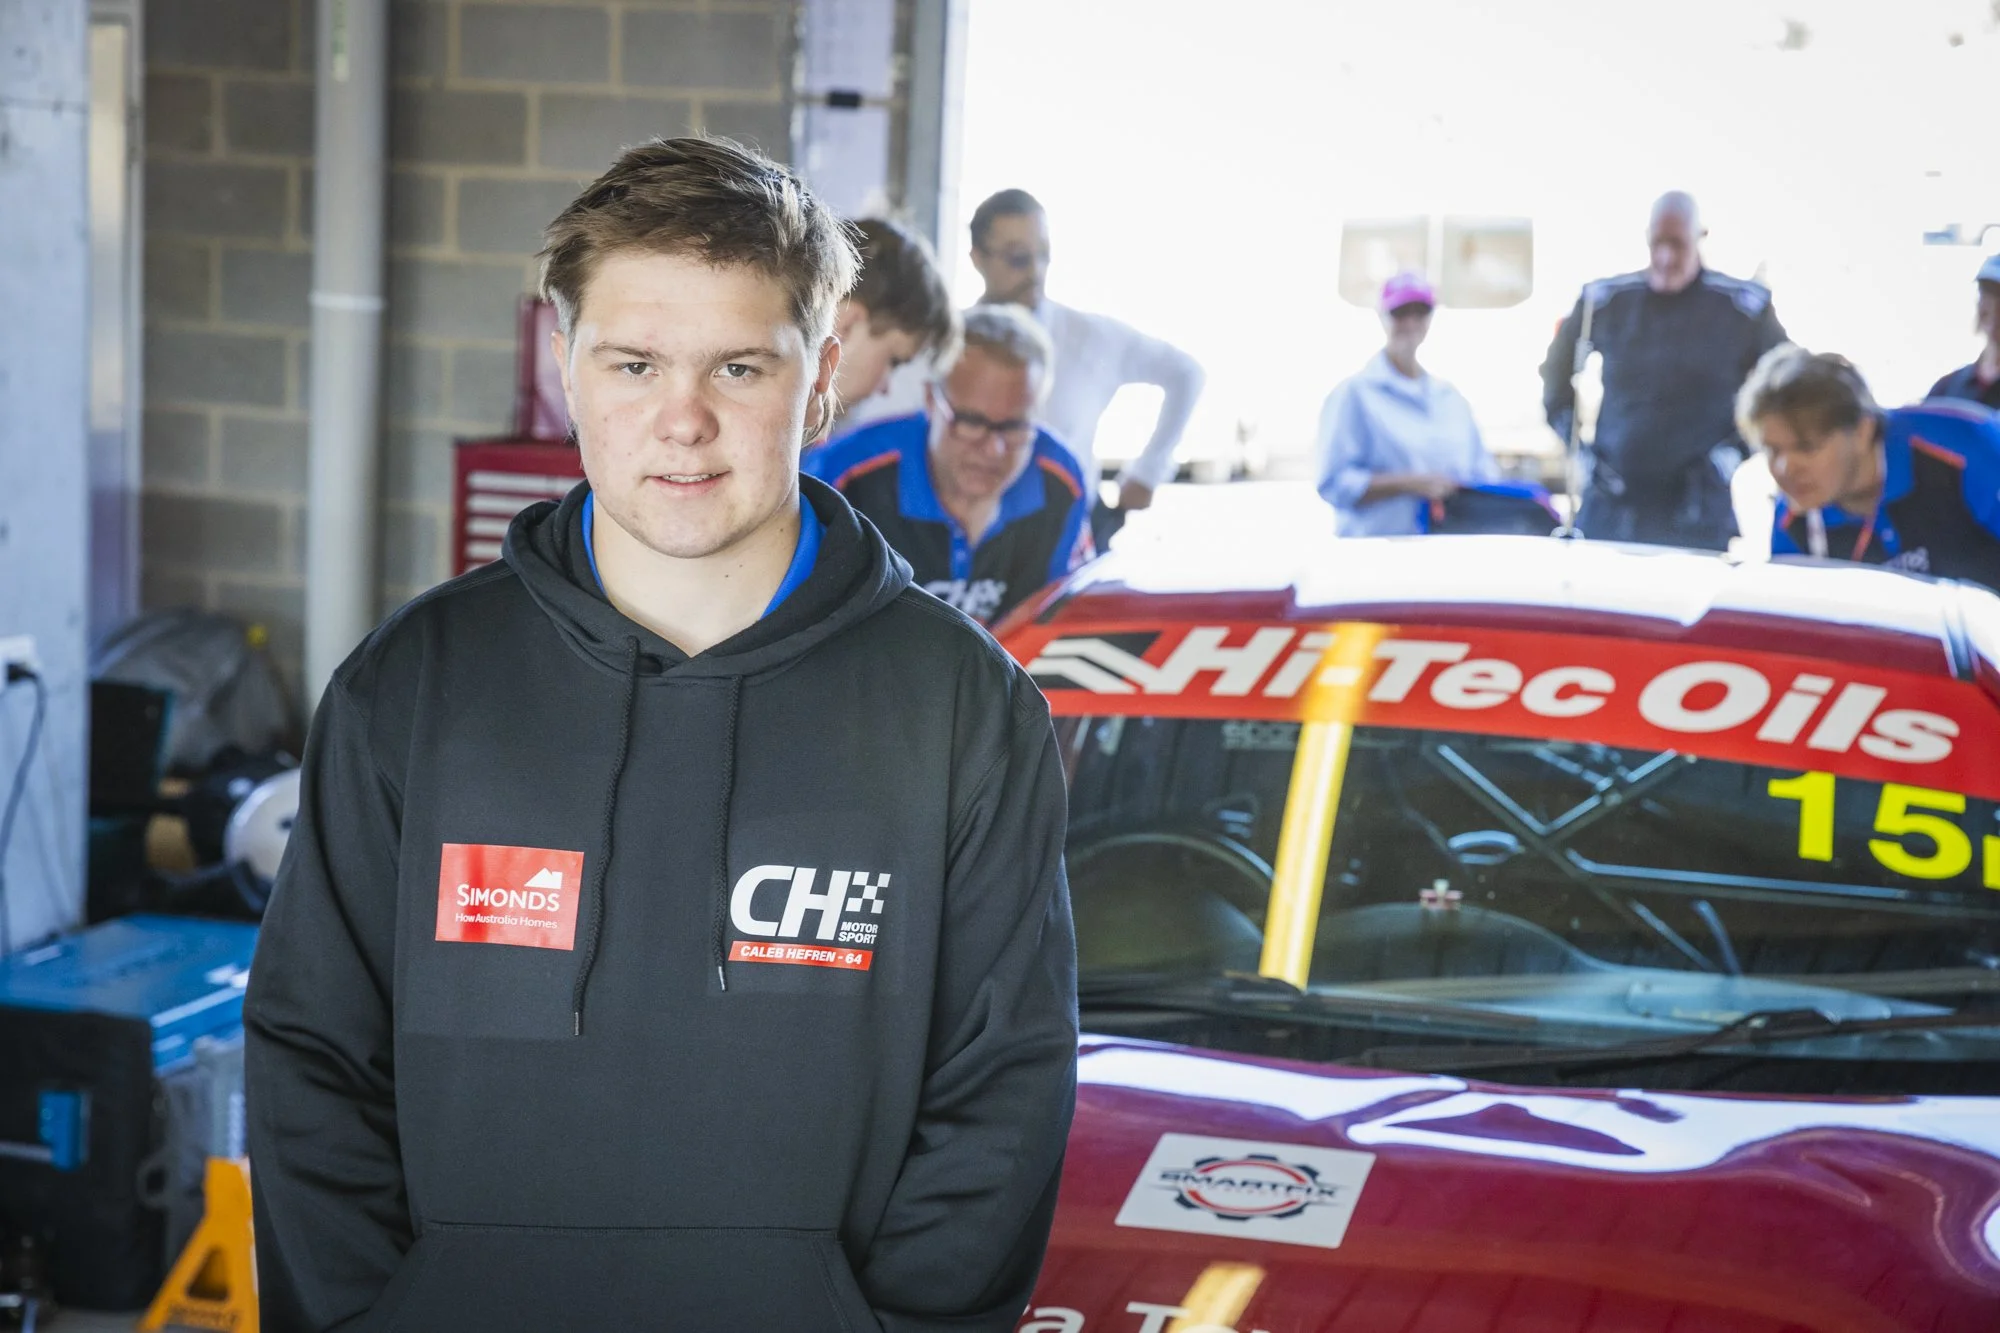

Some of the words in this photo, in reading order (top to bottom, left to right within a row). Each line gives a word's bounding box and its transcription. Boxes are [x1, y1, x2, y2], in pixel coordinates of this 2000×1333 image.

[1140, 627, 1616, 717] Hi-Tec
[1638, 661, 1960, 763] Oils
[456, 883, 560, 912] SIMONDS
[730, 864, 851, 941] CH
[455, 912, 476, 923] How
[475, 913, 518, 926] Australia
[520, 917, 558, 929] Homes
[841, 921, 879, 934] MOTOR
[838, 932, 877, 945] SPORT
[740, 945, 784, 959] CALEB
[786, 948, 836, 962] HEFREN
[845, 953, 862, 965] 64
